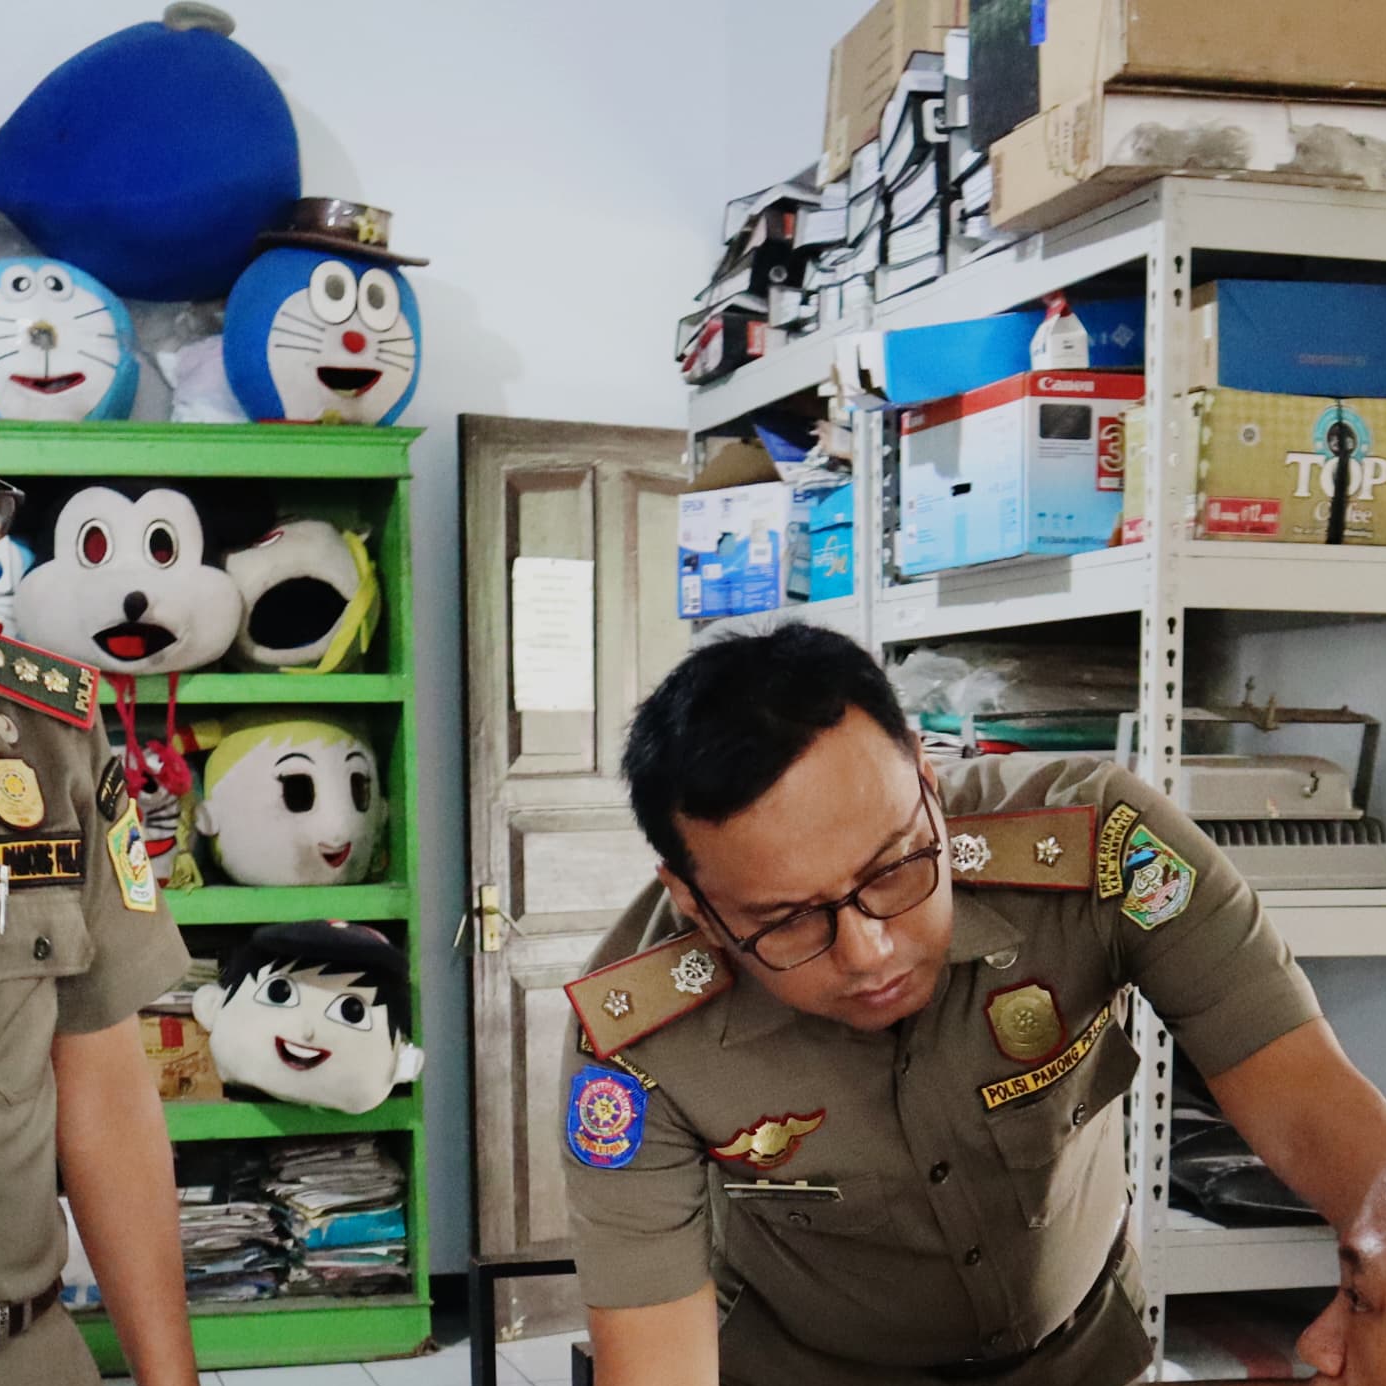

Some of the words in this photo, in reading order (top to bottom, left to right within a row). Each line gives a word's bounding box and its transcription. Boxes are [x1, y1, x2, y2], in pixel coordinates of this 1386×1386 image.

[1038, 376, 1095, 392] Canon
[987, 1078, 1030, 1104] POLISI
[1032, 1046, 1080, 1088] PAMONG
